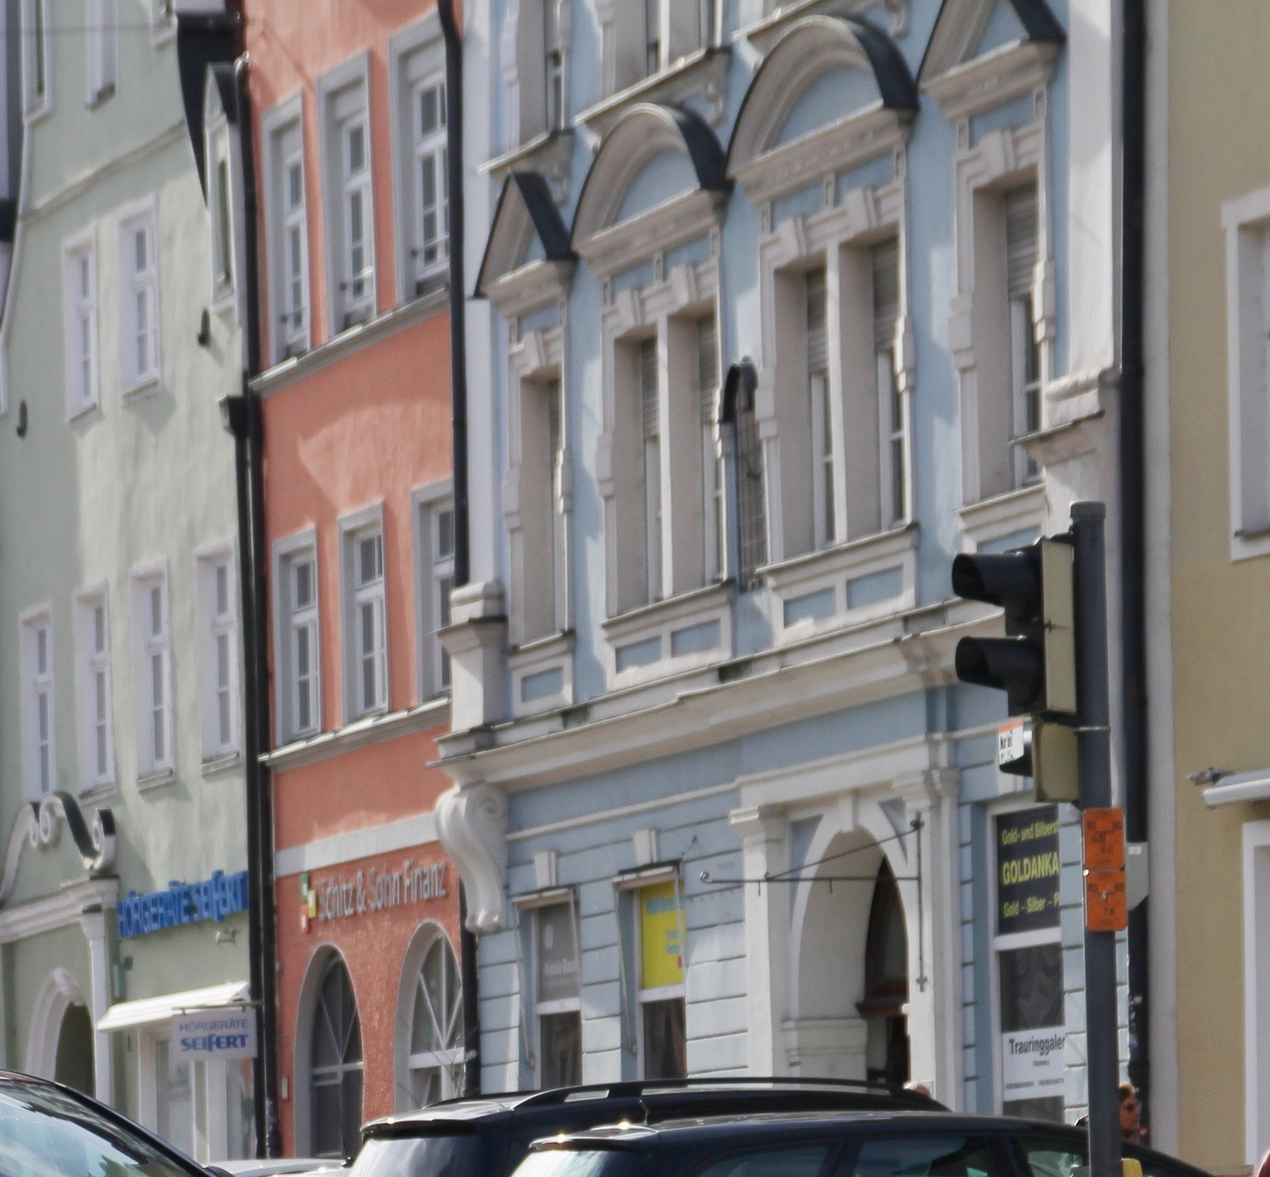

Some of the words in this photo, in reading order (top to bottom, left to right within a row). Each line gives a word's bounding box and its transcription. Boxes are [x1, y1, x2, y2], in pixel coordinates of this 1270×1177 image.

[356, 869, 367, 914] &
[368, 862, 401, 912] Sohn
[403, 857, 447, 904] Finanz
[1004, 901, 1020, 918] Gold
[180, 1018, 249, 1032] HÖRGERÄTE
[181, 1033, 249, 1052] SEIFERT
